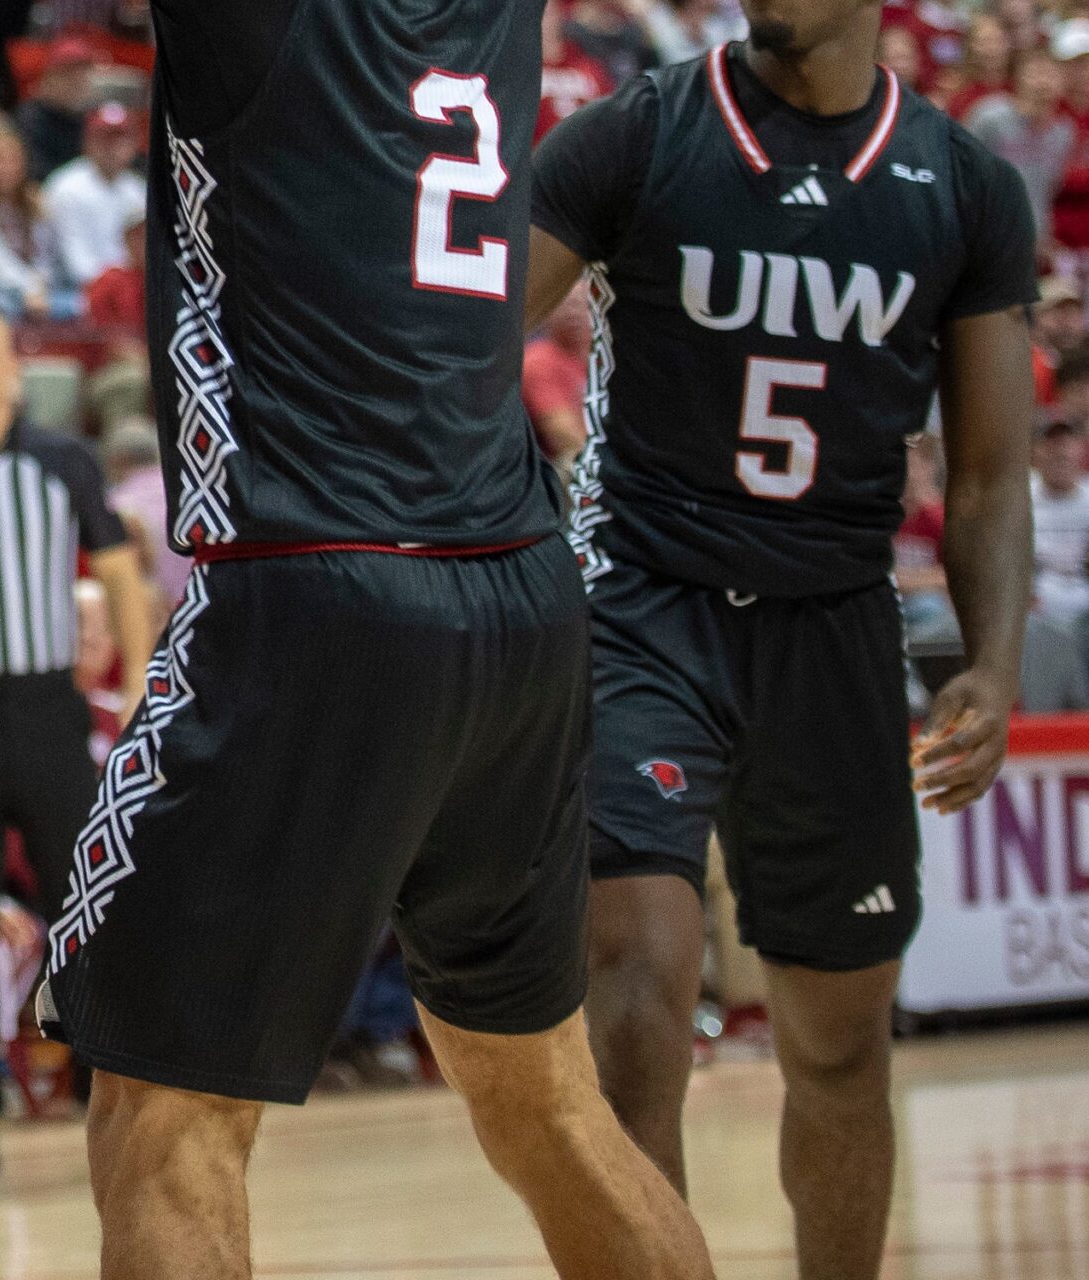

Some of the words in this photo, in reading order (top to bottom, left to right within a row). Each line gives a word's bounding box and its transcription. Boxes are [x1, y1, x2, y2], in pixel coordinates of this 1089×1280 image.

[411, 67, 510, 302] 2
[678, 244, 916, 347] UIW
[734, 355, 828, 503] 5
